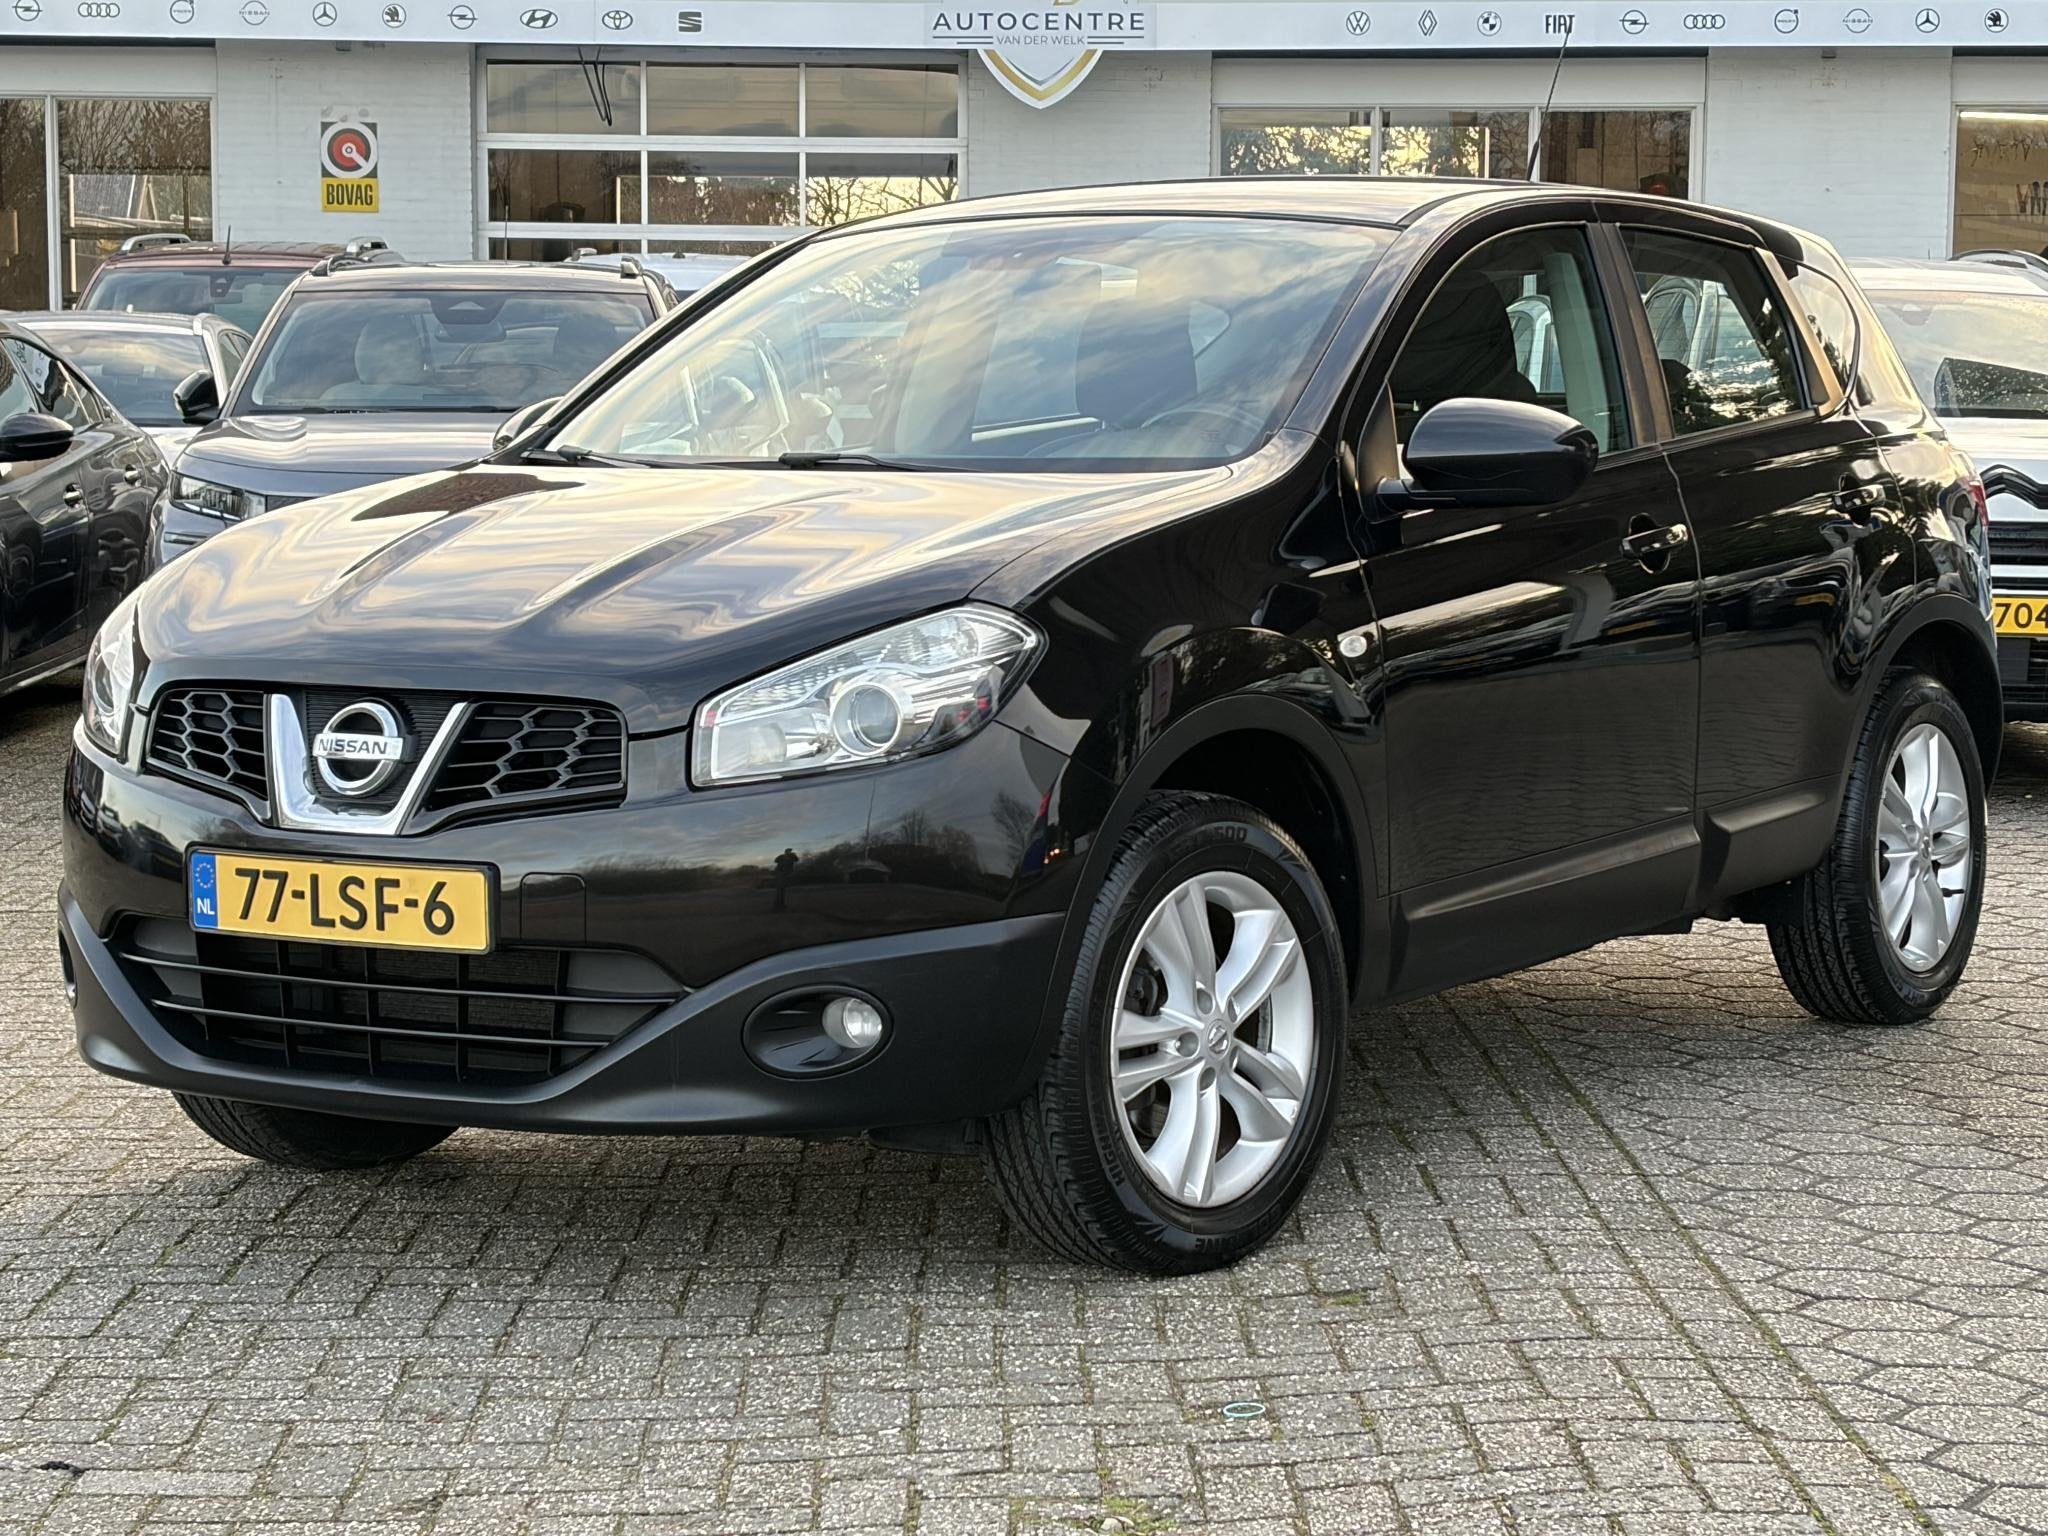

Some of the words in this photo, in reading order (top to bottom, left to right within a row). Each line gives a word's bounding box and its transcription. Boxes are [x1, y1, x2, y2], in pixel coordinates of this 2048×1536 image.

[932, 12, 1145, 31] AUTOCENTRE
[1544, 14, 1576, 34] FIAT
[996, 35, 1021, 45] VAN
[1023, 35, 1049, 45] DER
[1051, 35, 1086, 45] WELK
[325, 183, 374, 206] BOVAG
[1994, 602, 2048, 629] 704
[316, 737, 389, 755] NISSAN
[196, 898, 215, 916] NL
[234, 866, 455, 936] 77-LSF-6
